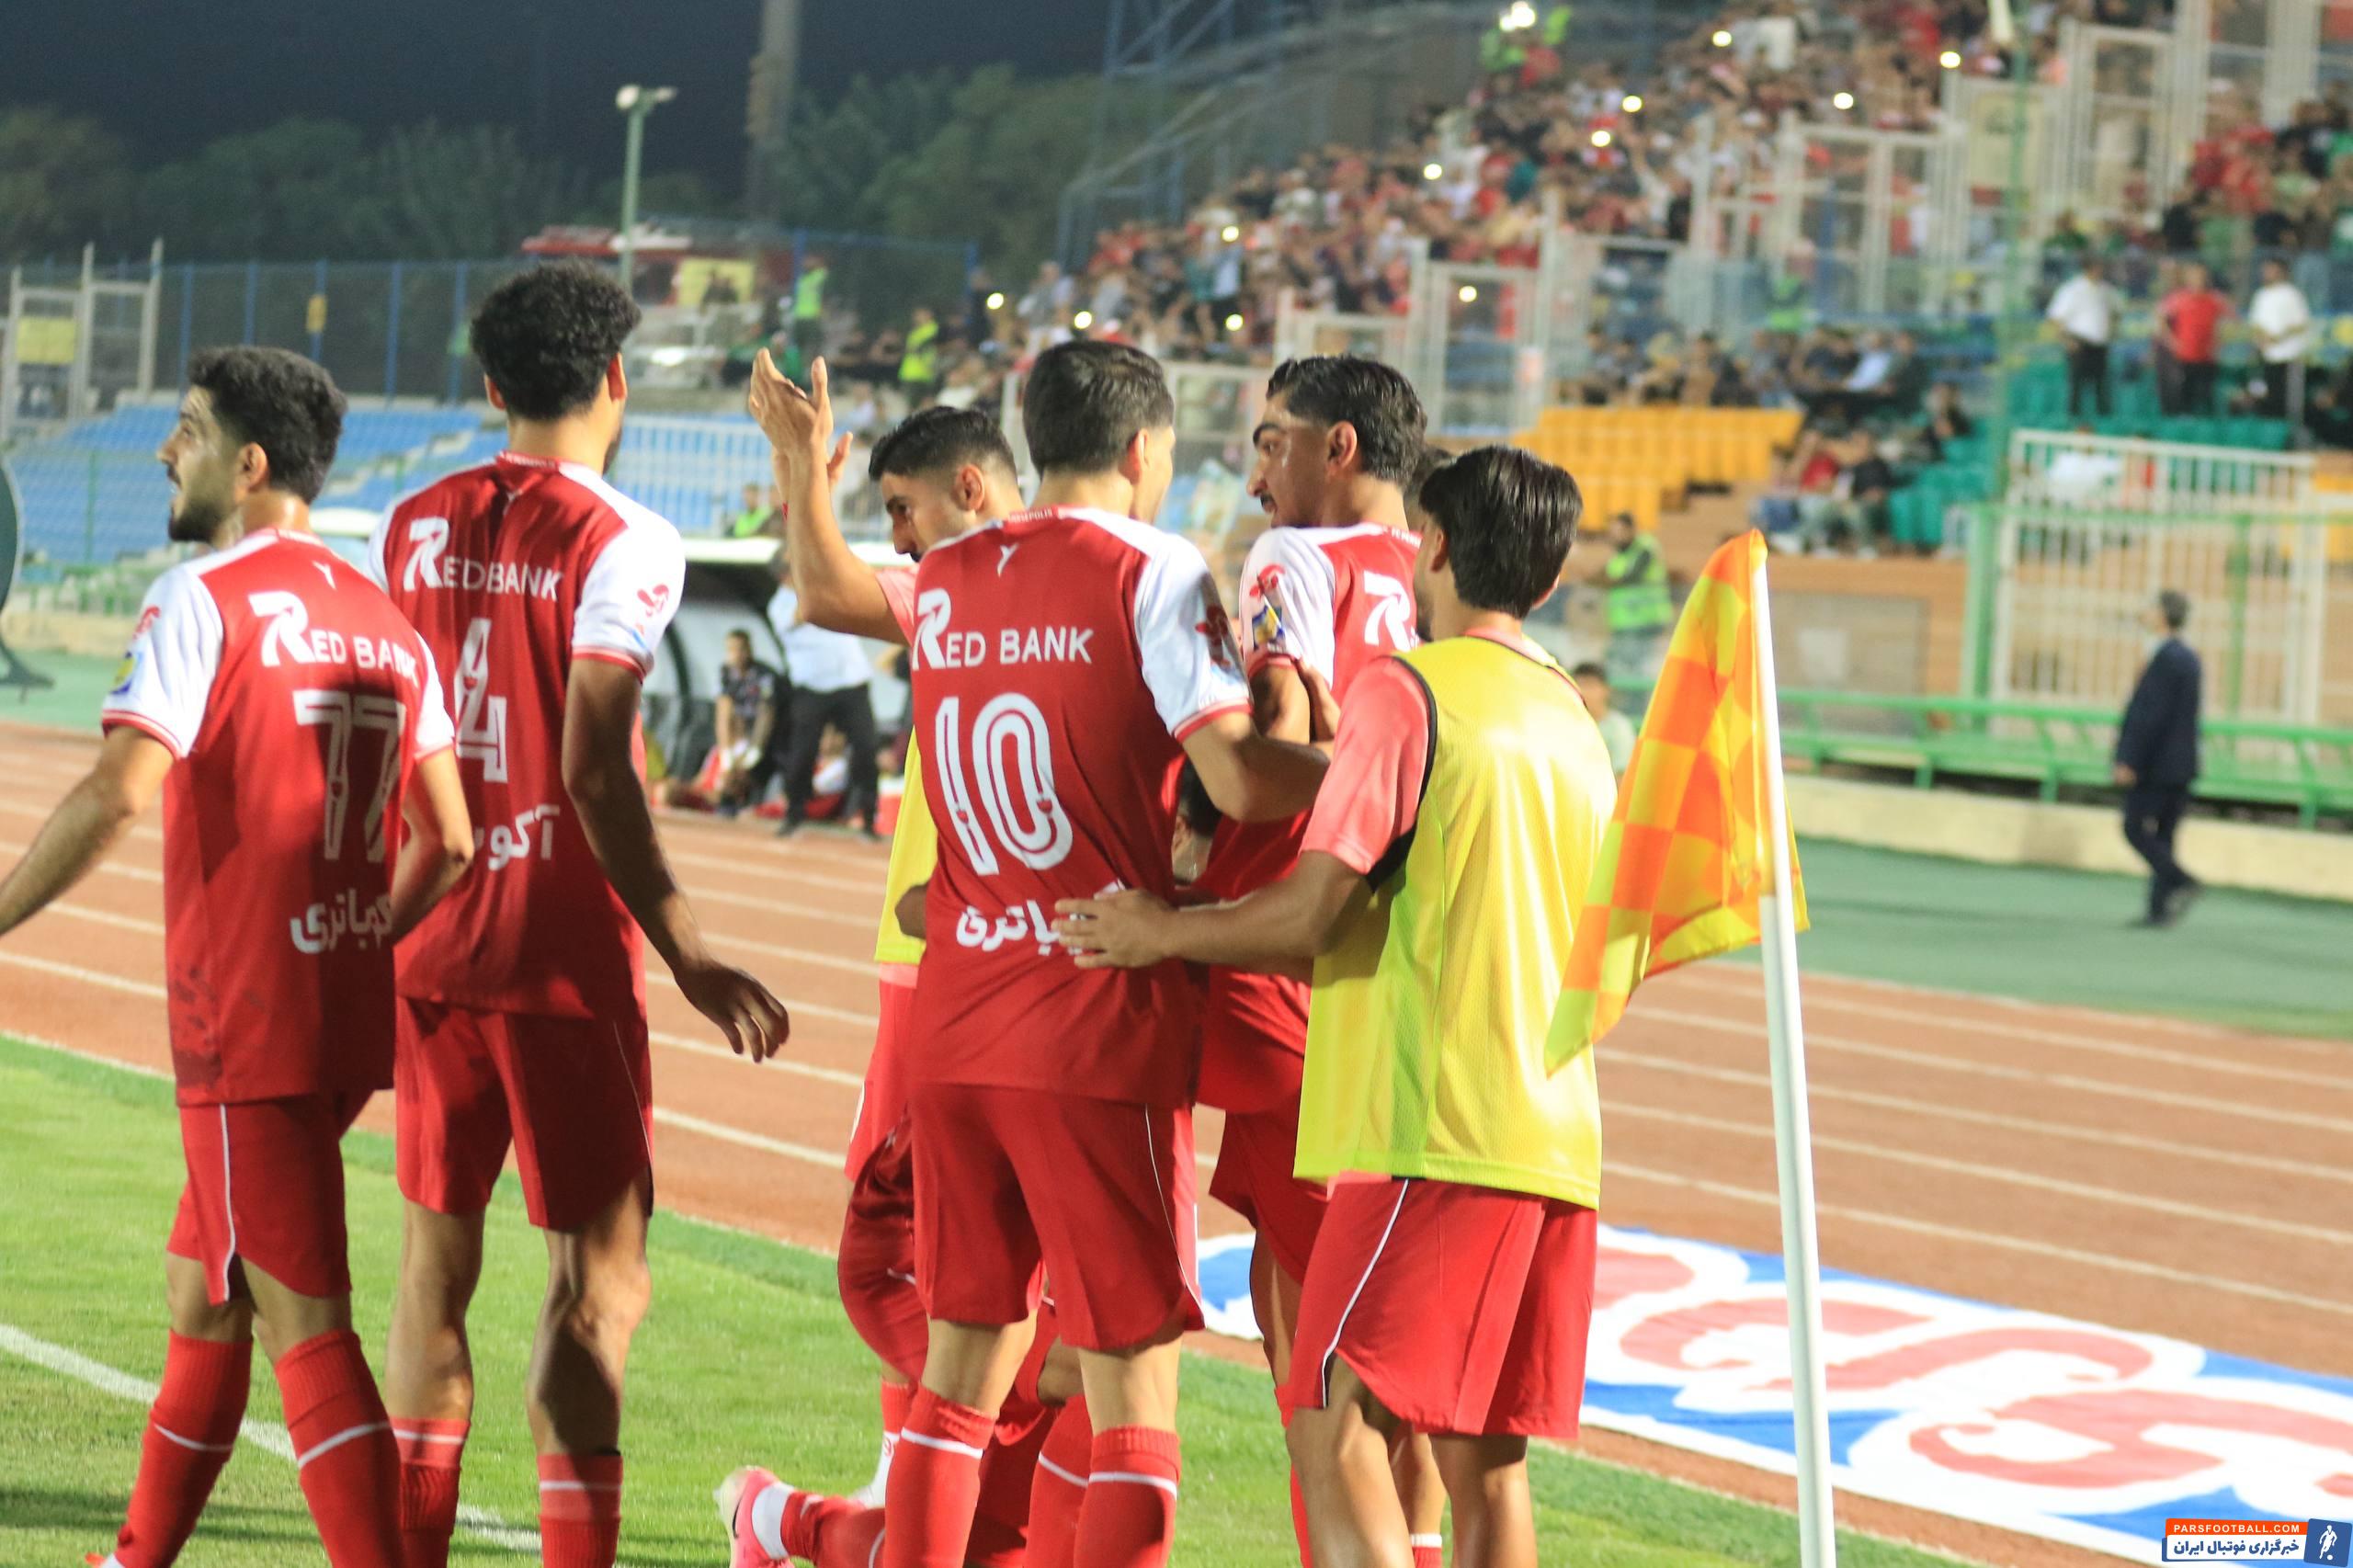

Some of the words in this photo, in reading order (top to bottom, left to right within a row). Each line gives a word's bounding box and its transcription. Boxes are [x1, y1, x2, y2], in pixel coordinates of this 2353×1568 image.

[248, 591, 347, 667] RED
[454, 617, 508, 783] 4
[912, 588, 986, 670] RED
[1000, 627, 1094, 665] BANK
[292, 690, 407, 862] 77
[936, 692, 1074, 875] 10
